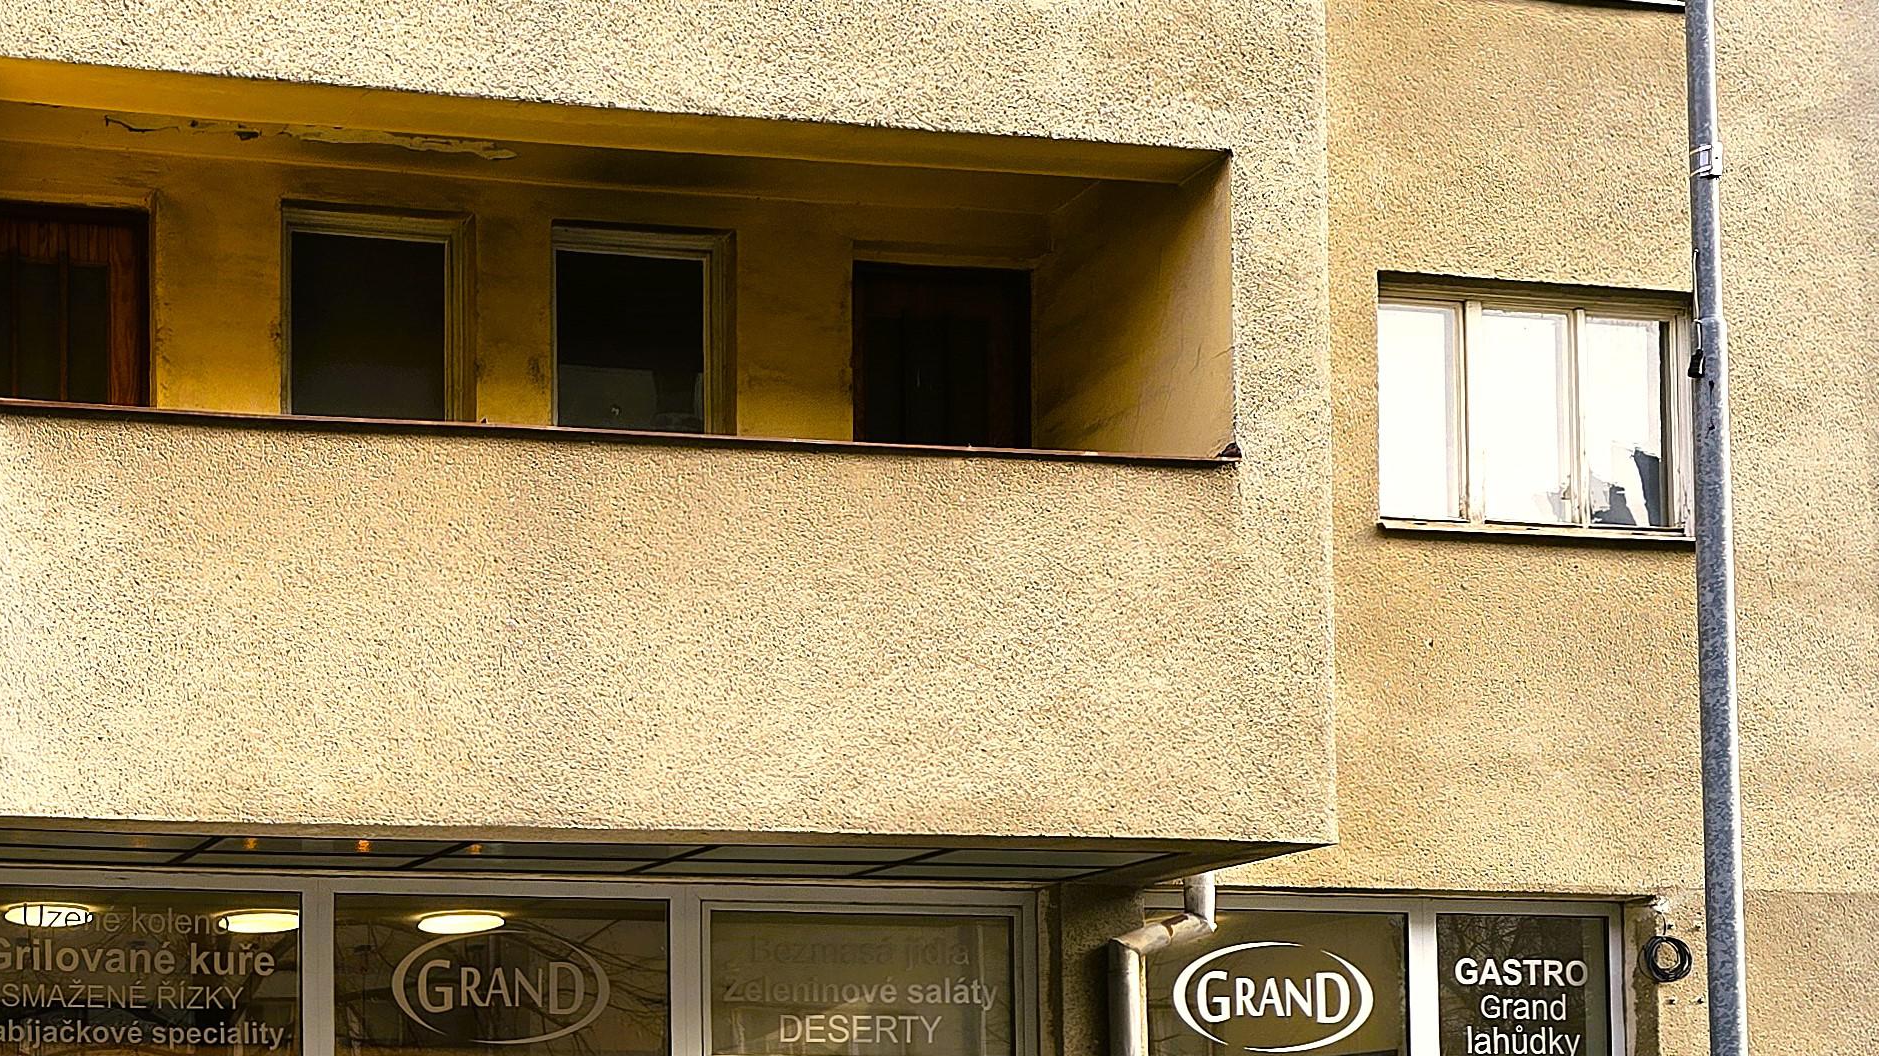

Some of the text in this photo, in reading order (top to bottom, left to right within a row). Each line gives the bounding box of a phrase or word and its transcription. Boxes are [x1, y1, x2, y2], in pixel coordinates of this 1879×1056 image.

[190, 942, 276, 977] kuře
[1454, 957, 1589, 988] GASTRO
[1, 978, 244, 1010] SMAŽENÉ ŘÍZKY
[417, 959, 586, 1015] GRAND
[723, 976, 998, 1012] Zeleninové saláty
[1196, 969, 1352, 1025] GRAND
[1480, 993, 1568, 1022] Grand
[152, 1021, 285, 1051] speciality
[778, 1013, 943, 1045] DESERTY
